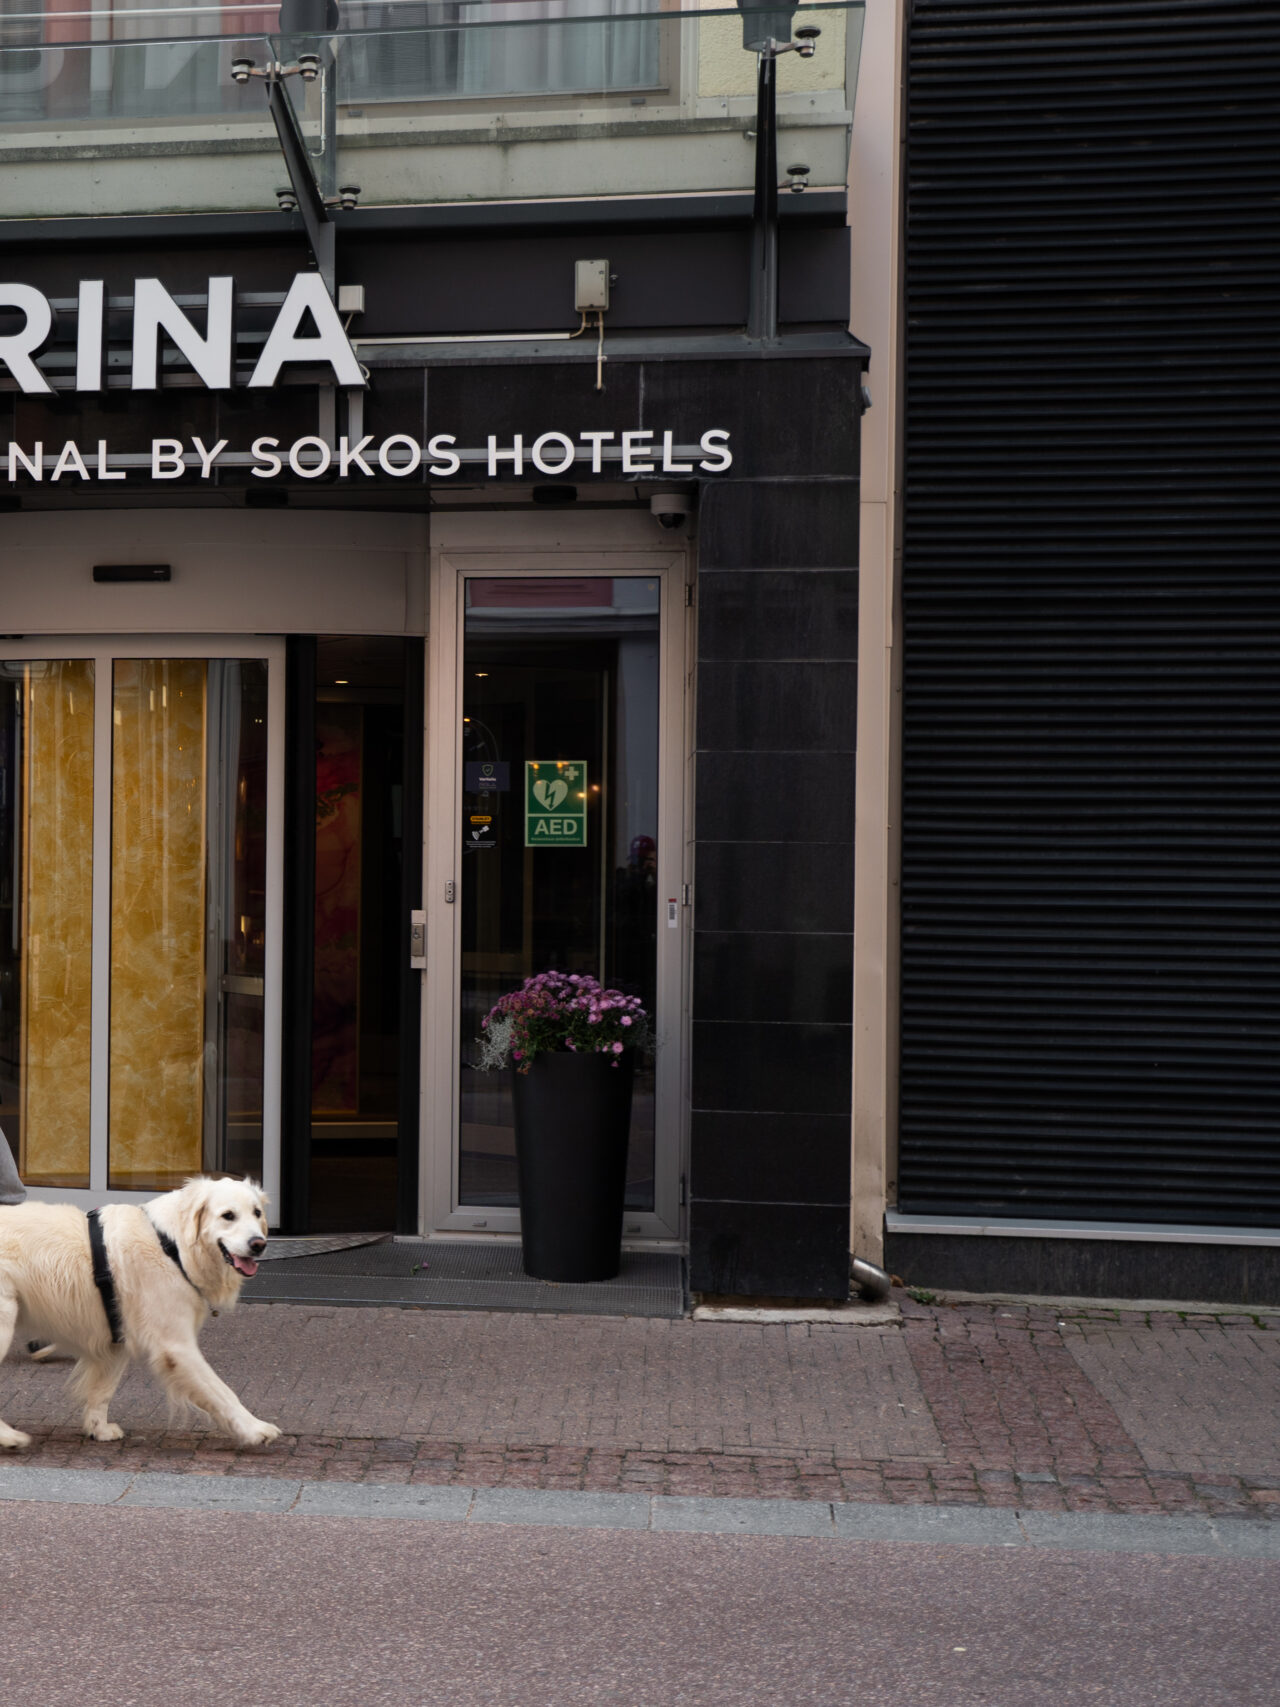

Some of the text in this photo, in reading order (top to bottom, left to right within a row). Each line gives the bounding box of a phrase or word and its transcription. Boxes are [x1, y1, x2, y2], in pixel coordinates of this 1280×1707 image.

[151, 437, 229, 480] BY
[250, 434, 462, 479] SOKOS
[487, 429, 734, 476] HOTELS
[534, 819, 578, 835] AED
